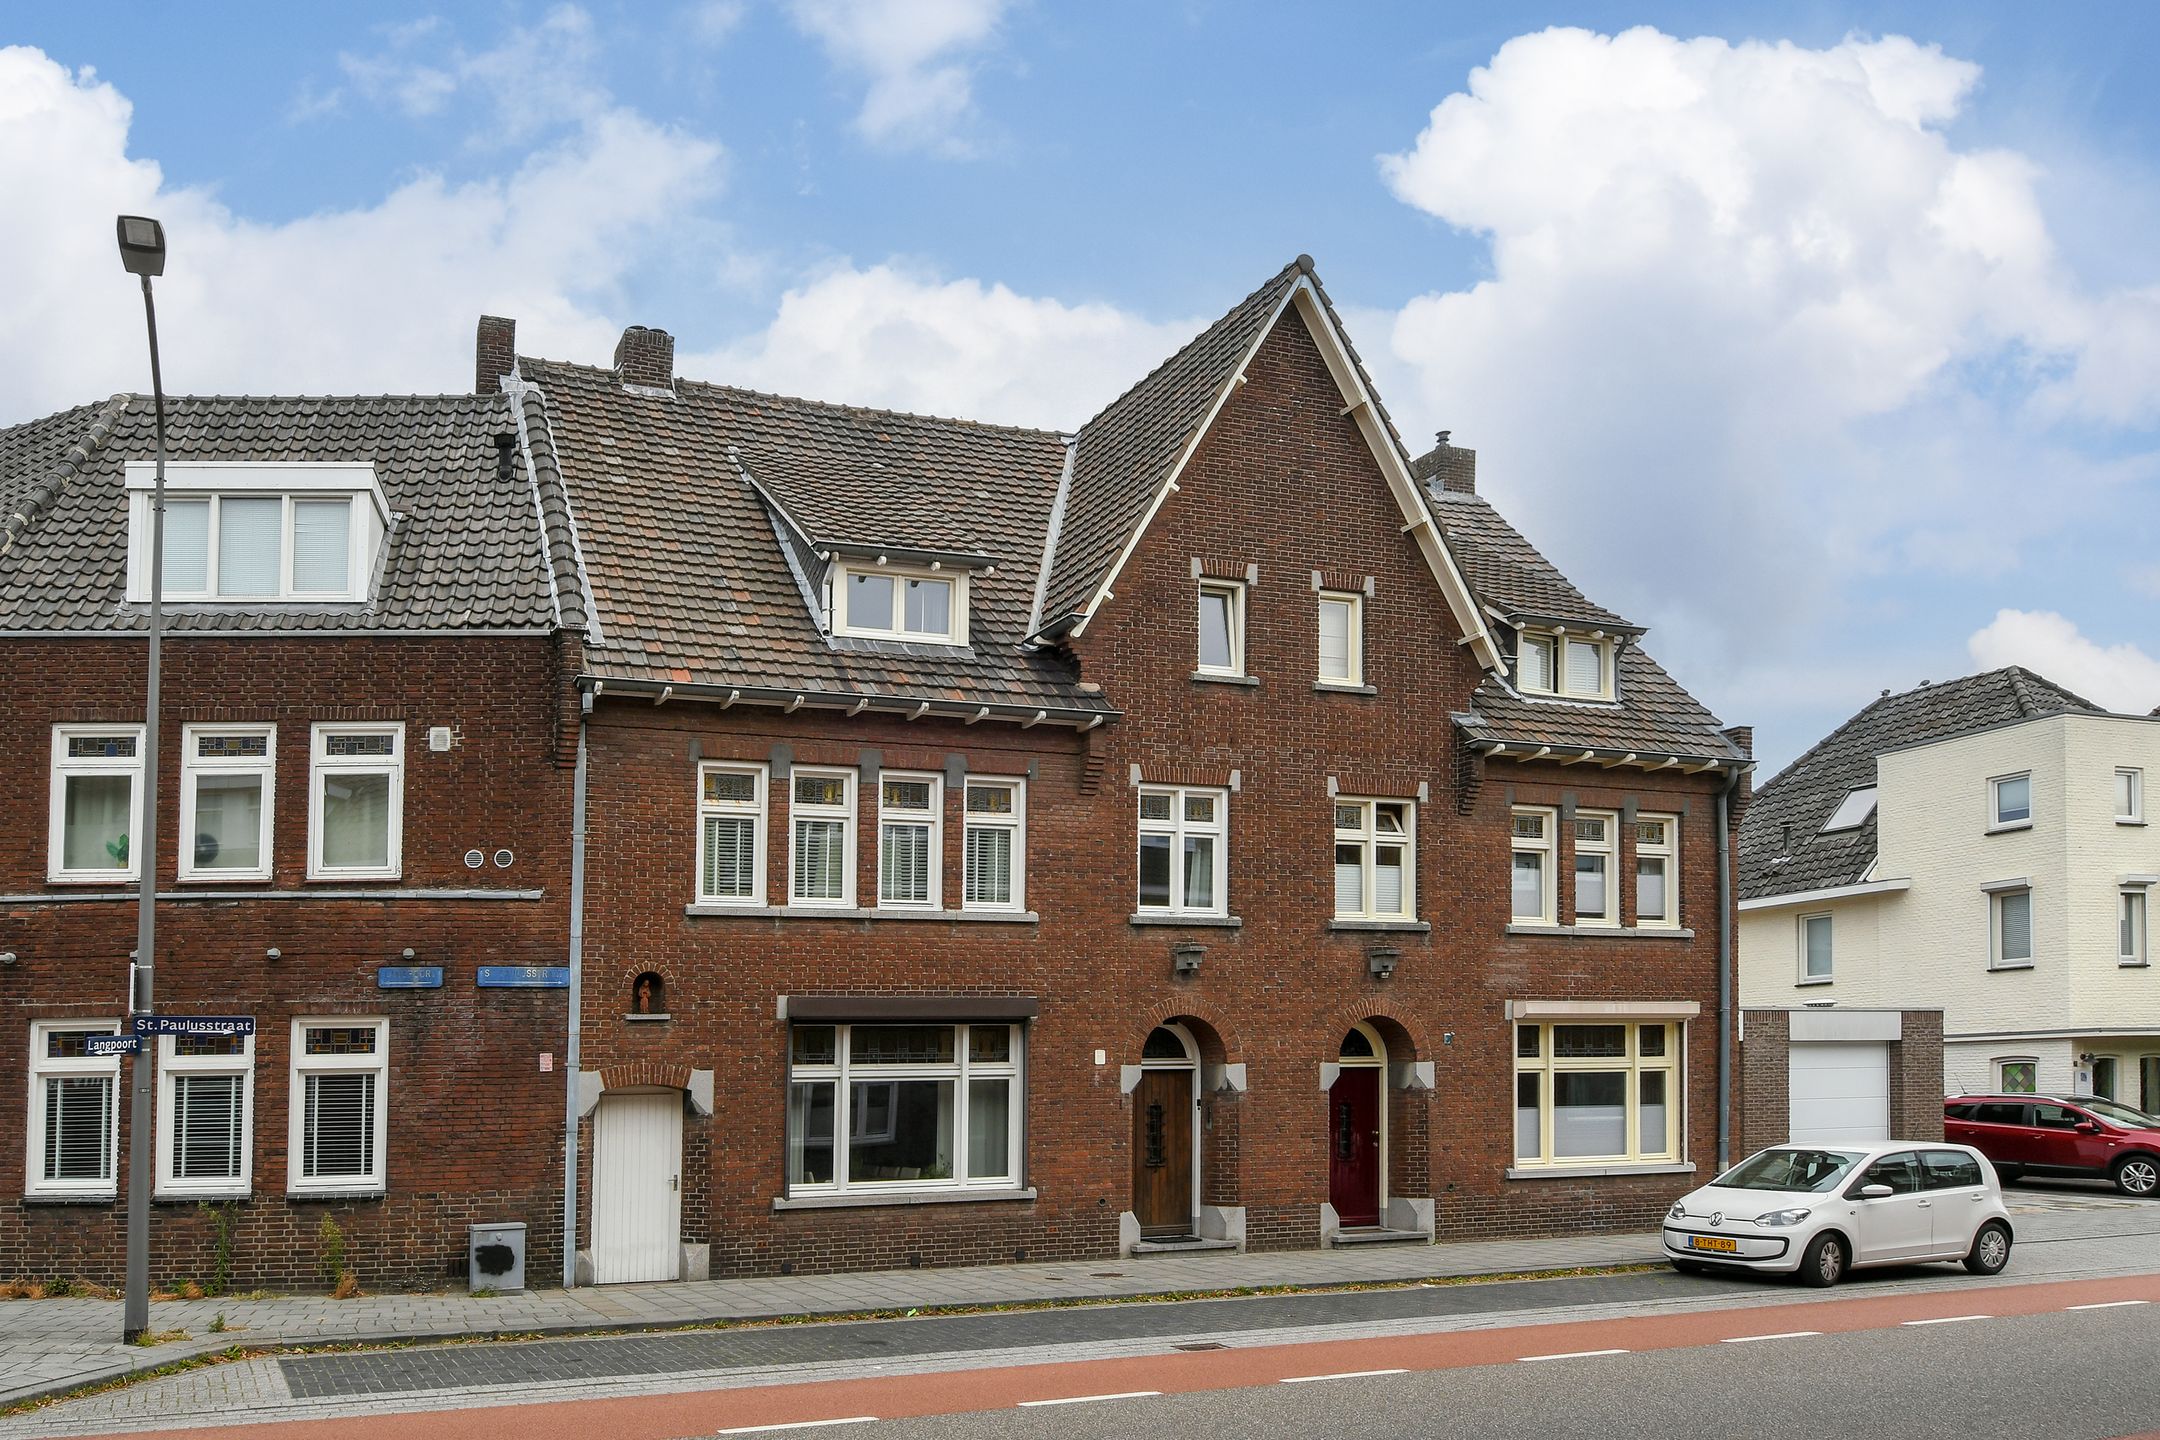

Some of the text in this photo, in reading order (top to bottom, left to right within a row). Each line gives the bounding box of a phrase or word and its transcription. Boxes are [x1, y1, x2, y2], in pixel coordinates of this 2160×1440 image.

[137, 1019, 251, 1031] St. Paulusstraat
[88, 1039, 137, 1052] Langpoort
[1694, 1238, 1732, 1249] 8-THT-89
